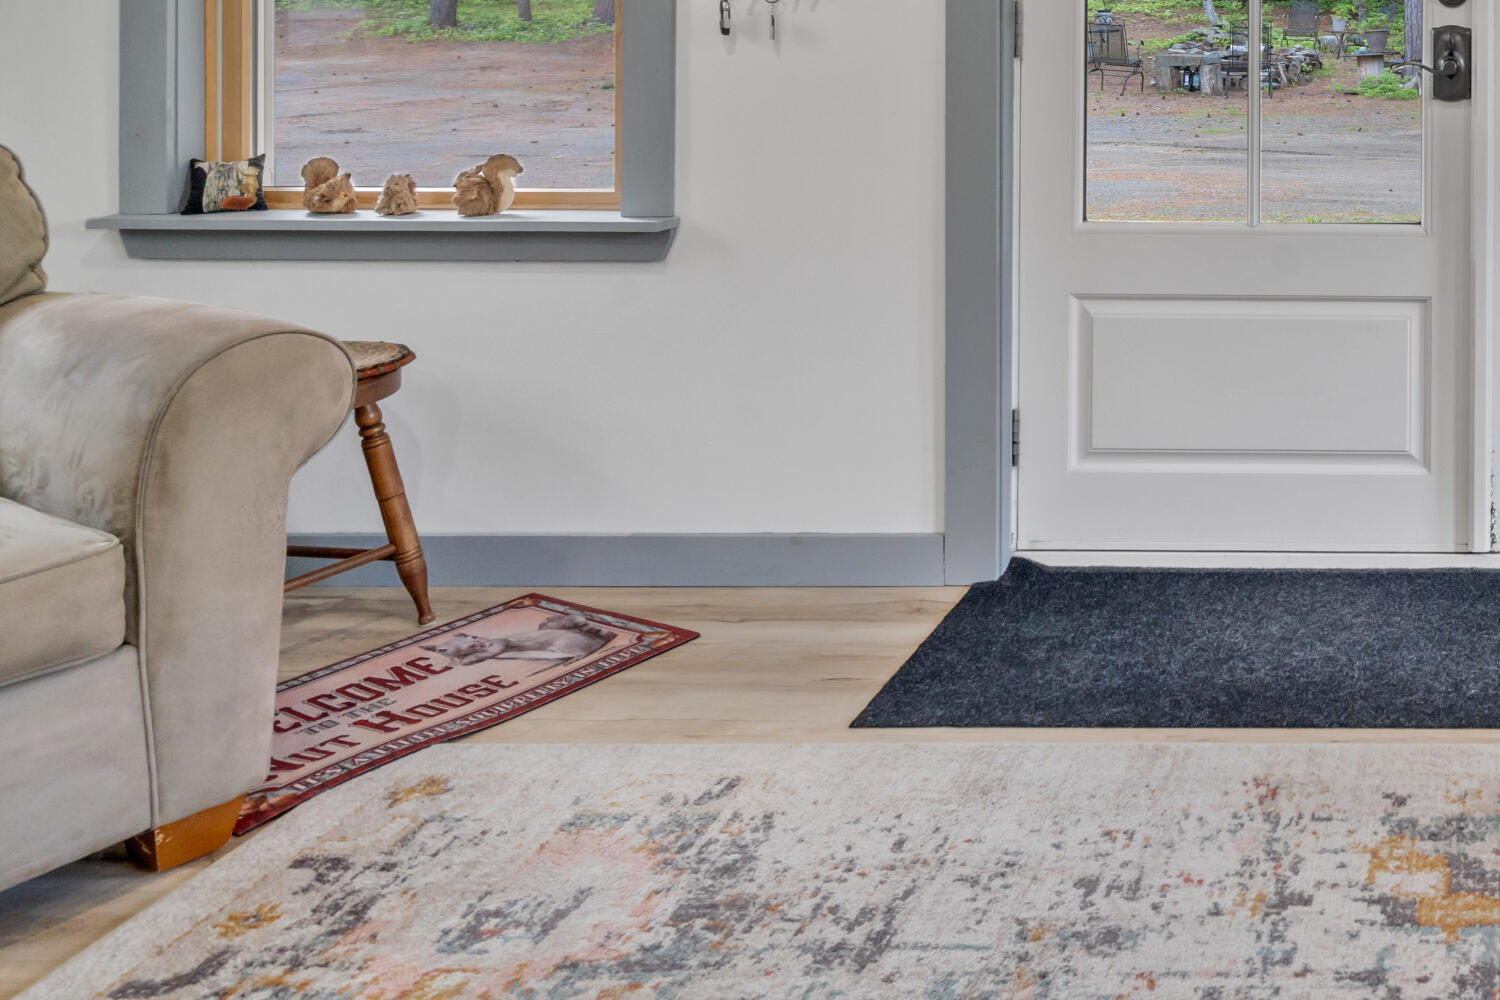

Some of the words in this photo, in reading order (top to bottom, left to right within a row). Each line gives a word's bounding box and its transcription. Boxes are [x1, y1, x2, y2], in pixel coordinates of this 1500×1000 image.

[272, 656, 453, 733] ELCOME
[573, 666, 597, 679] IN
[297, 719, 340, 735] TO
[338, 698, 397, 719] THE
[351, 674, 519, 733] HOUSE
